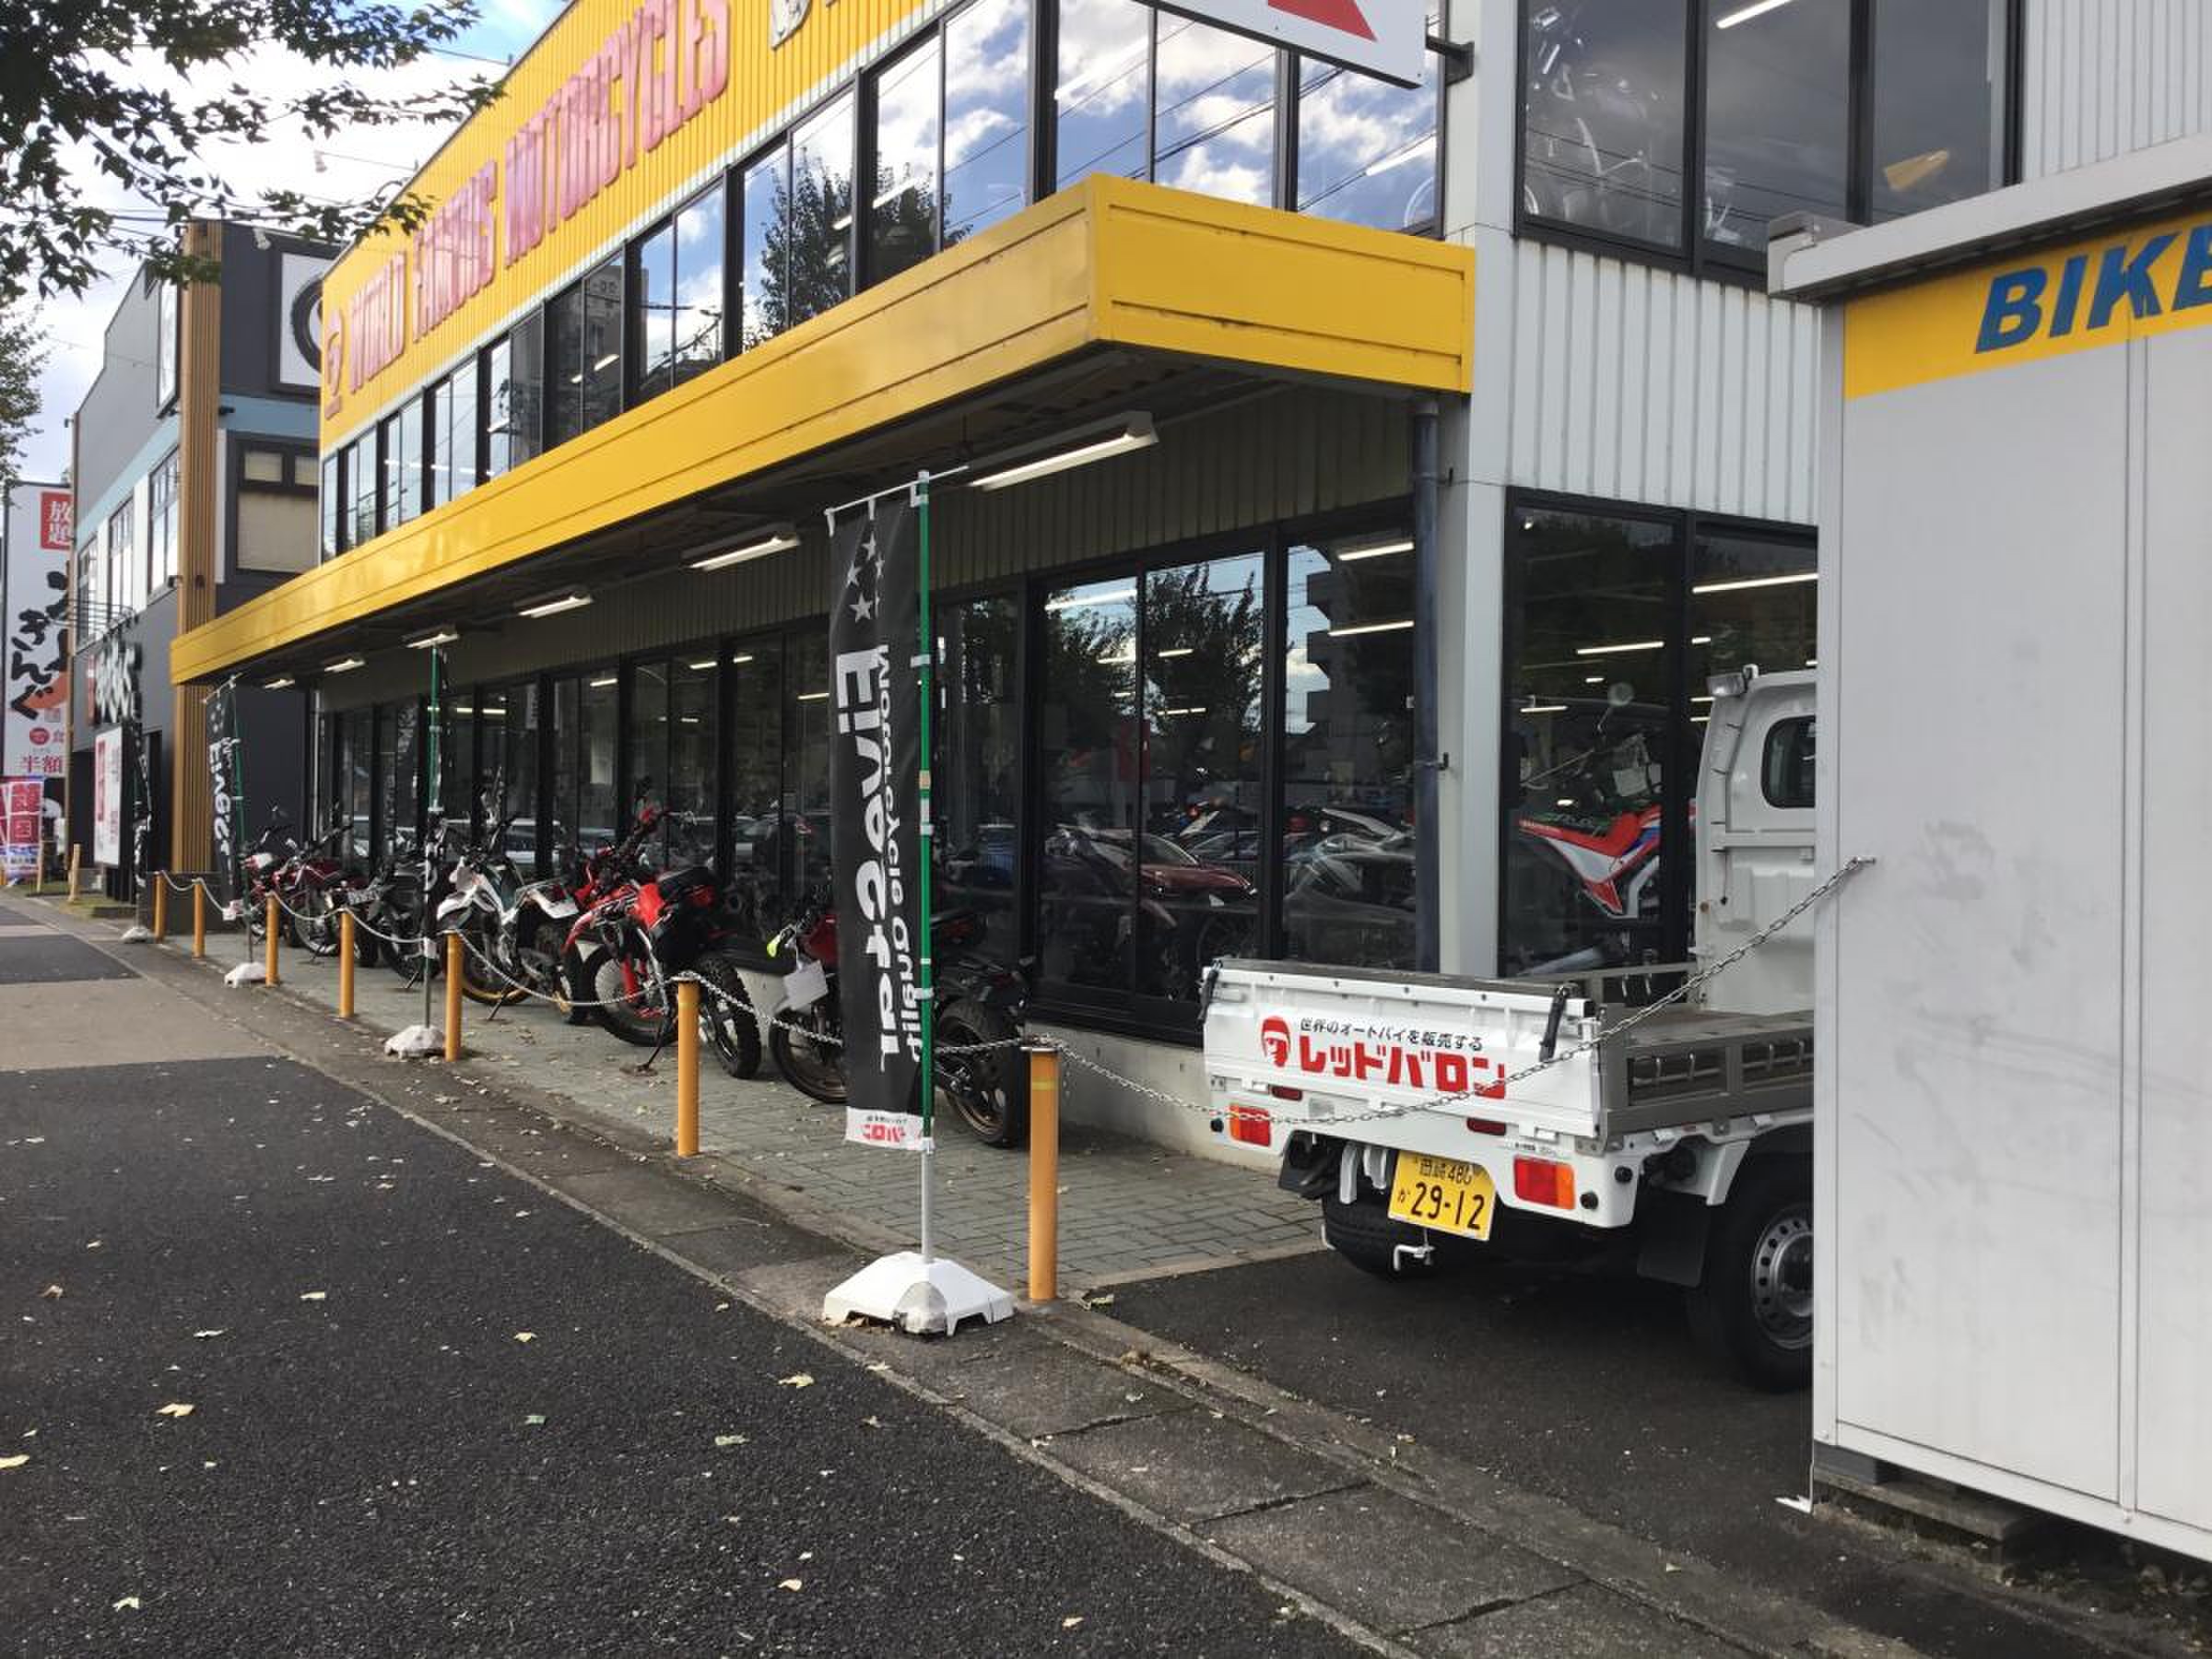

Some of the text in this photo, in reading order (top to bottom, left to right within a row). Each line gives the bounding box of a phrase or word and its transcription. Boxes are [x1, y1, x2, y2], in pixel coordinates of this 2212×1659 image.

[1300, 1018, 1483, 1052] 世界のオートバイを販売する
[1299, 1034, 1506, 1100] レッドバロン
[1410, 1181, 1485, 1230] 29-12
